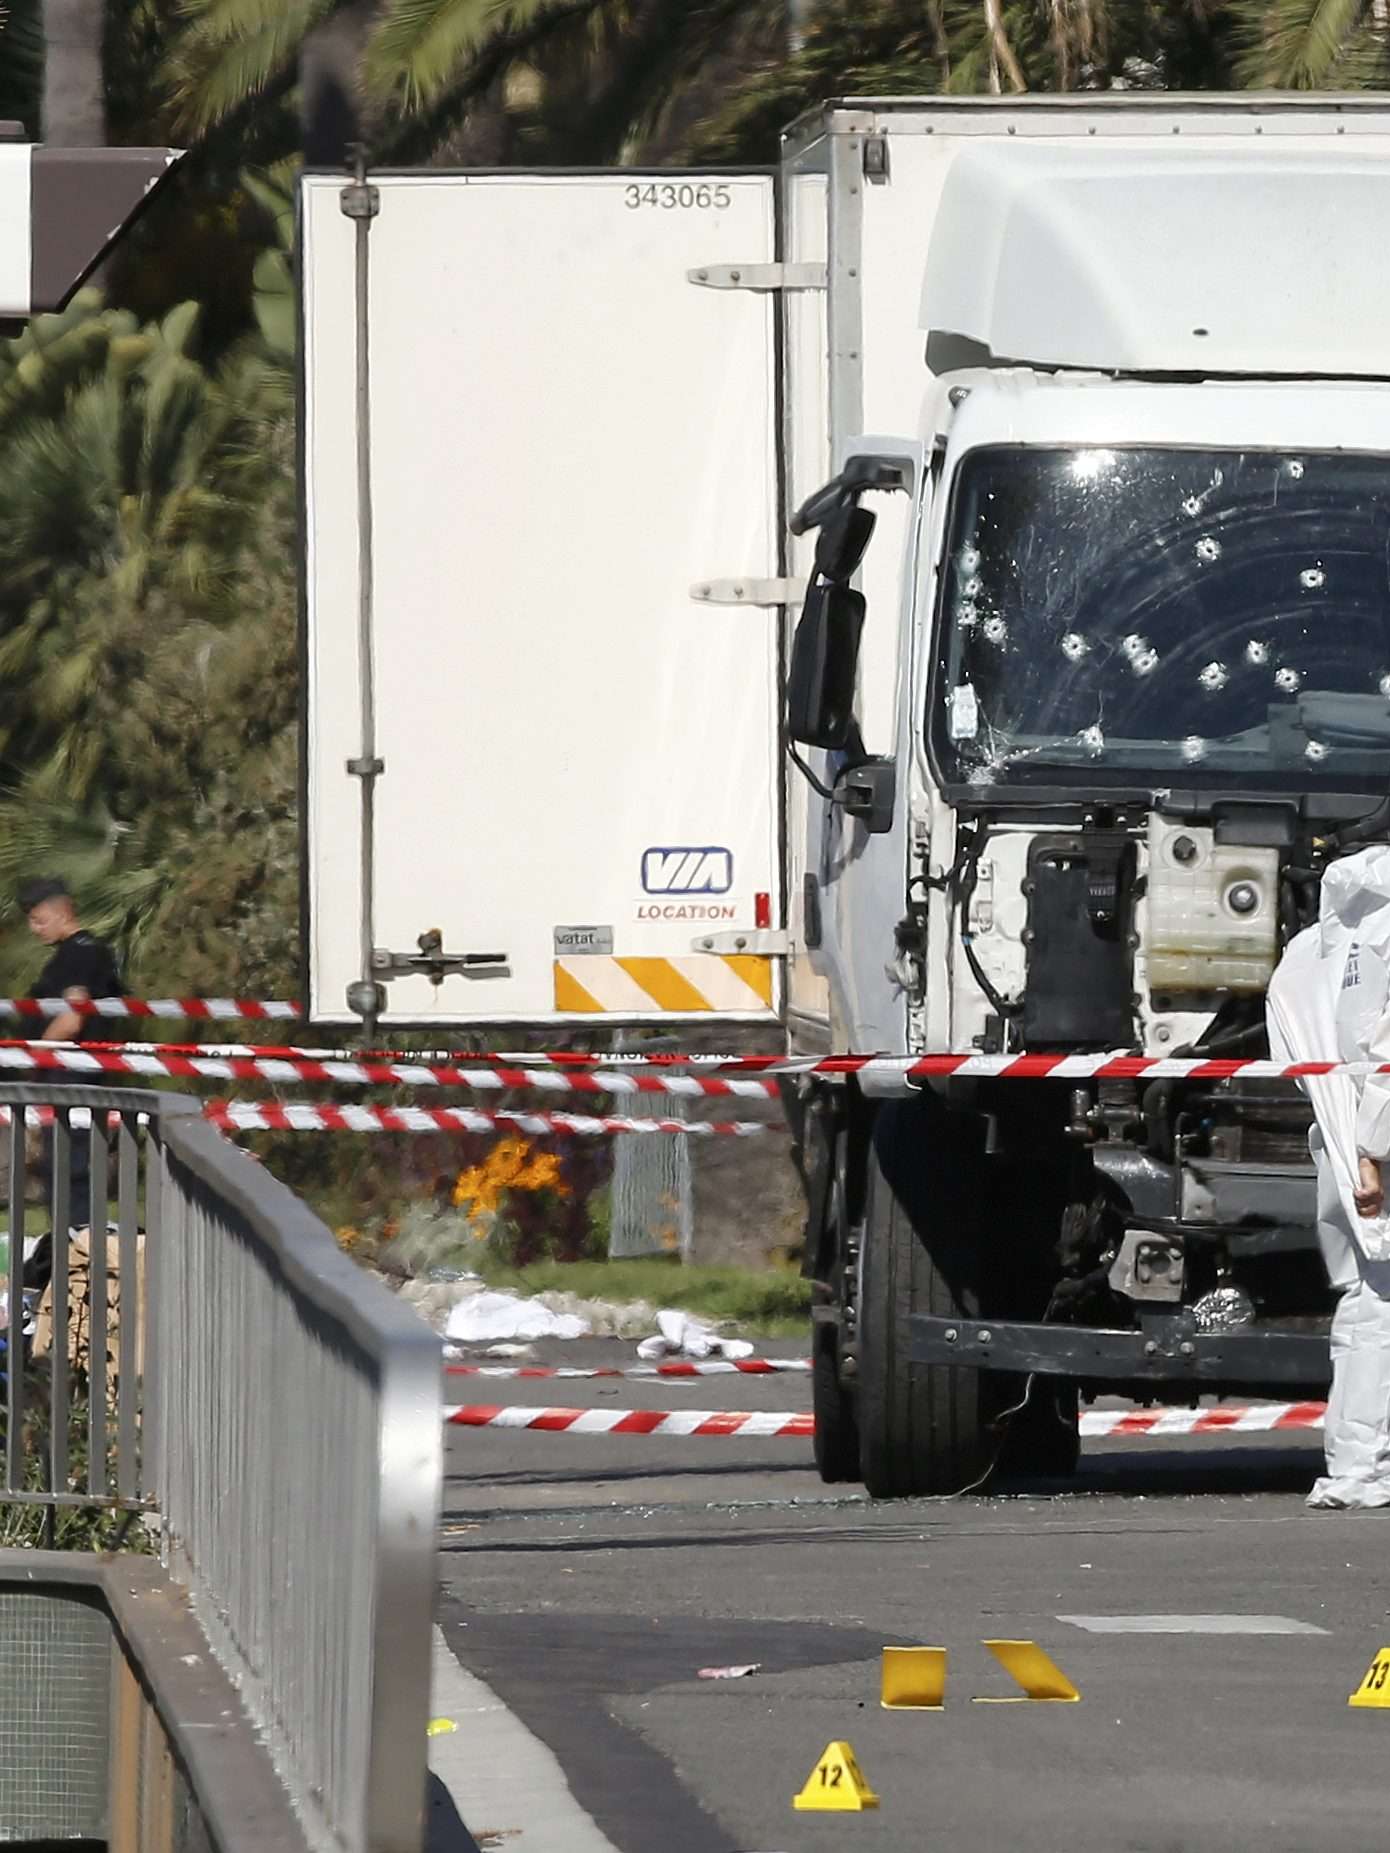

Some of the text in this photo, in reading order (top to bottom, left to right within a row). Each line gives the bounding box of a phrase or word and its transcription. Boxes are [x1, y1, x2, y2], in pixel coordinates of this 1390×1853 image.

[624, 184, 732, 209] 343065
[644, 849, 731, 892] VIA
[637, 905, 736, 920] LOCATION
[1366, 1660, 1390, 1690] 13
[819, 1764, 842, 1788] 12
